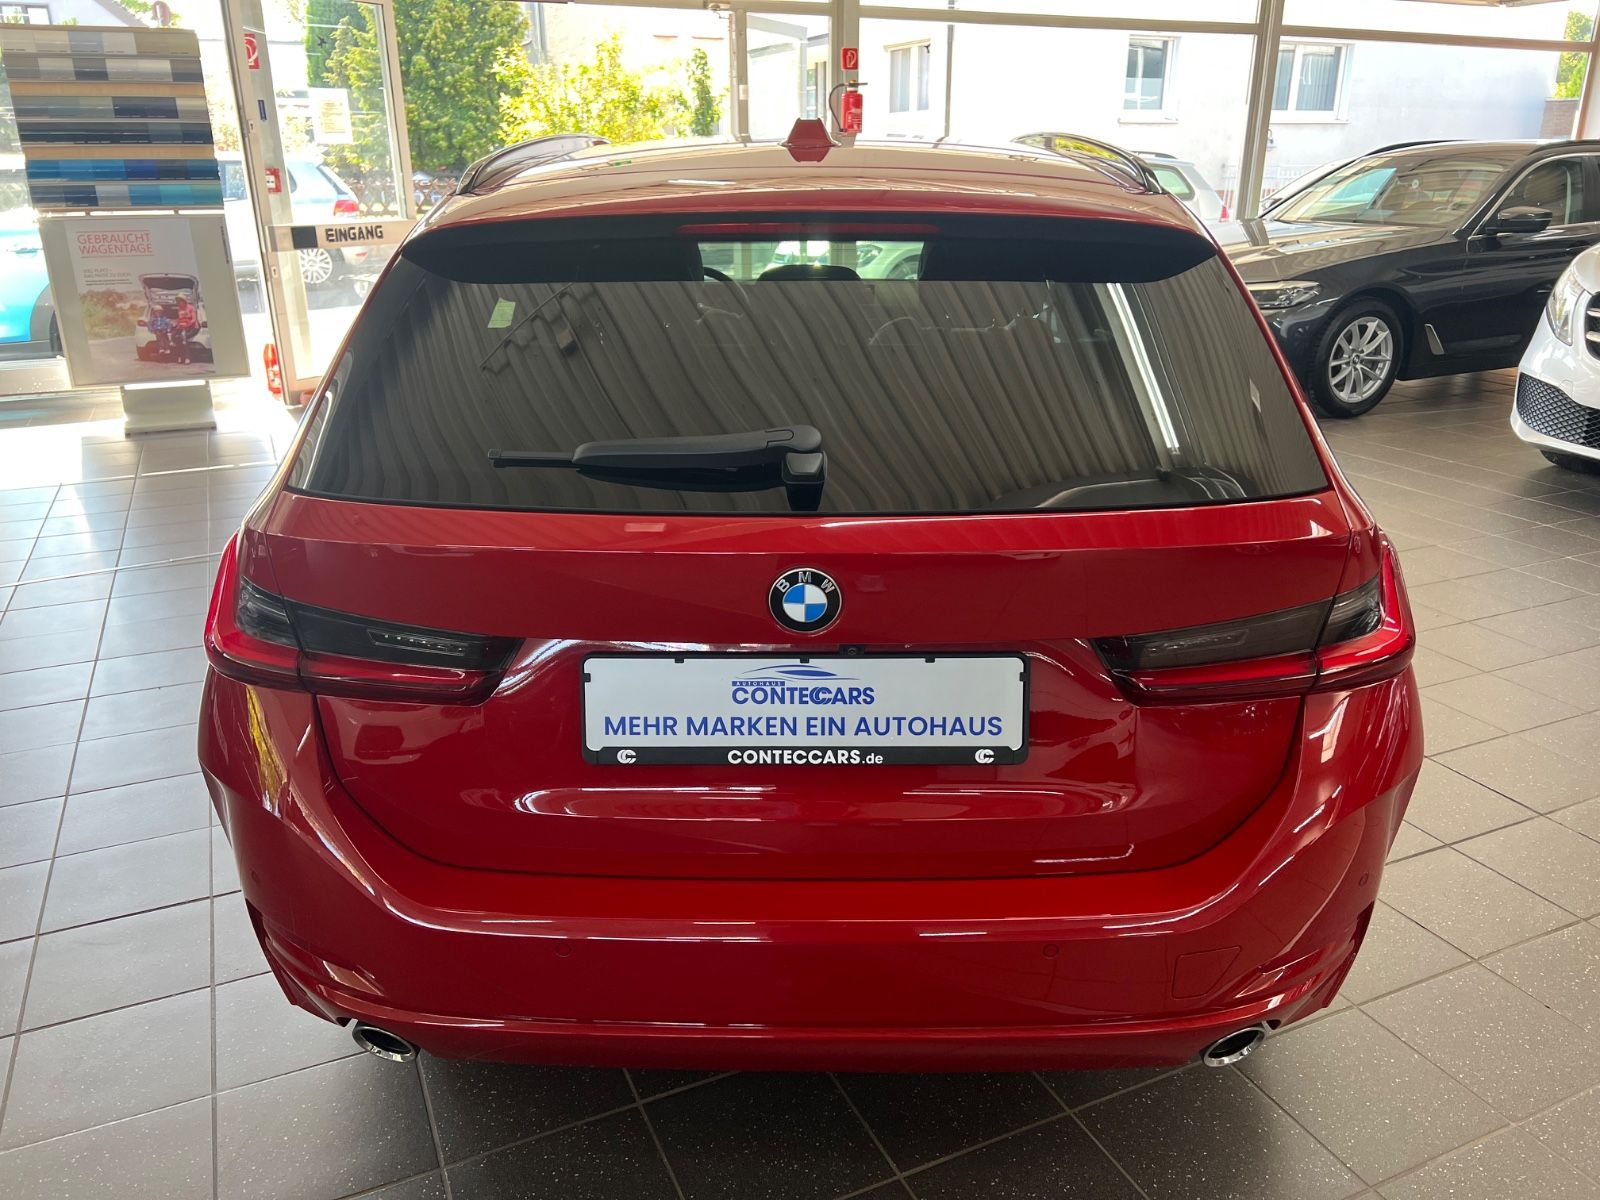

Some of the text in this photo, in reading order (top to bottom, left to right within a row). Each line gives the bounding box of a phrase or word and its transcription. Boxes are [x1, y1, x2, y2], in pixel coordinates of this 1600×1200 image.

[77, 232, 151, 245] GEBRAUCHT
[325, 225, 384, 242] EINGANG
[79, 242, 153, 255] WAGENTAGE
[775, 571, 835, 594] BMW
[731, 686, 875, 705] CONTECCARS
[604, 716, 1003, 736] MEHR MARKEN EIN AUTOHAUS
[727, 749, 884, 765] CONTECCARS.de
